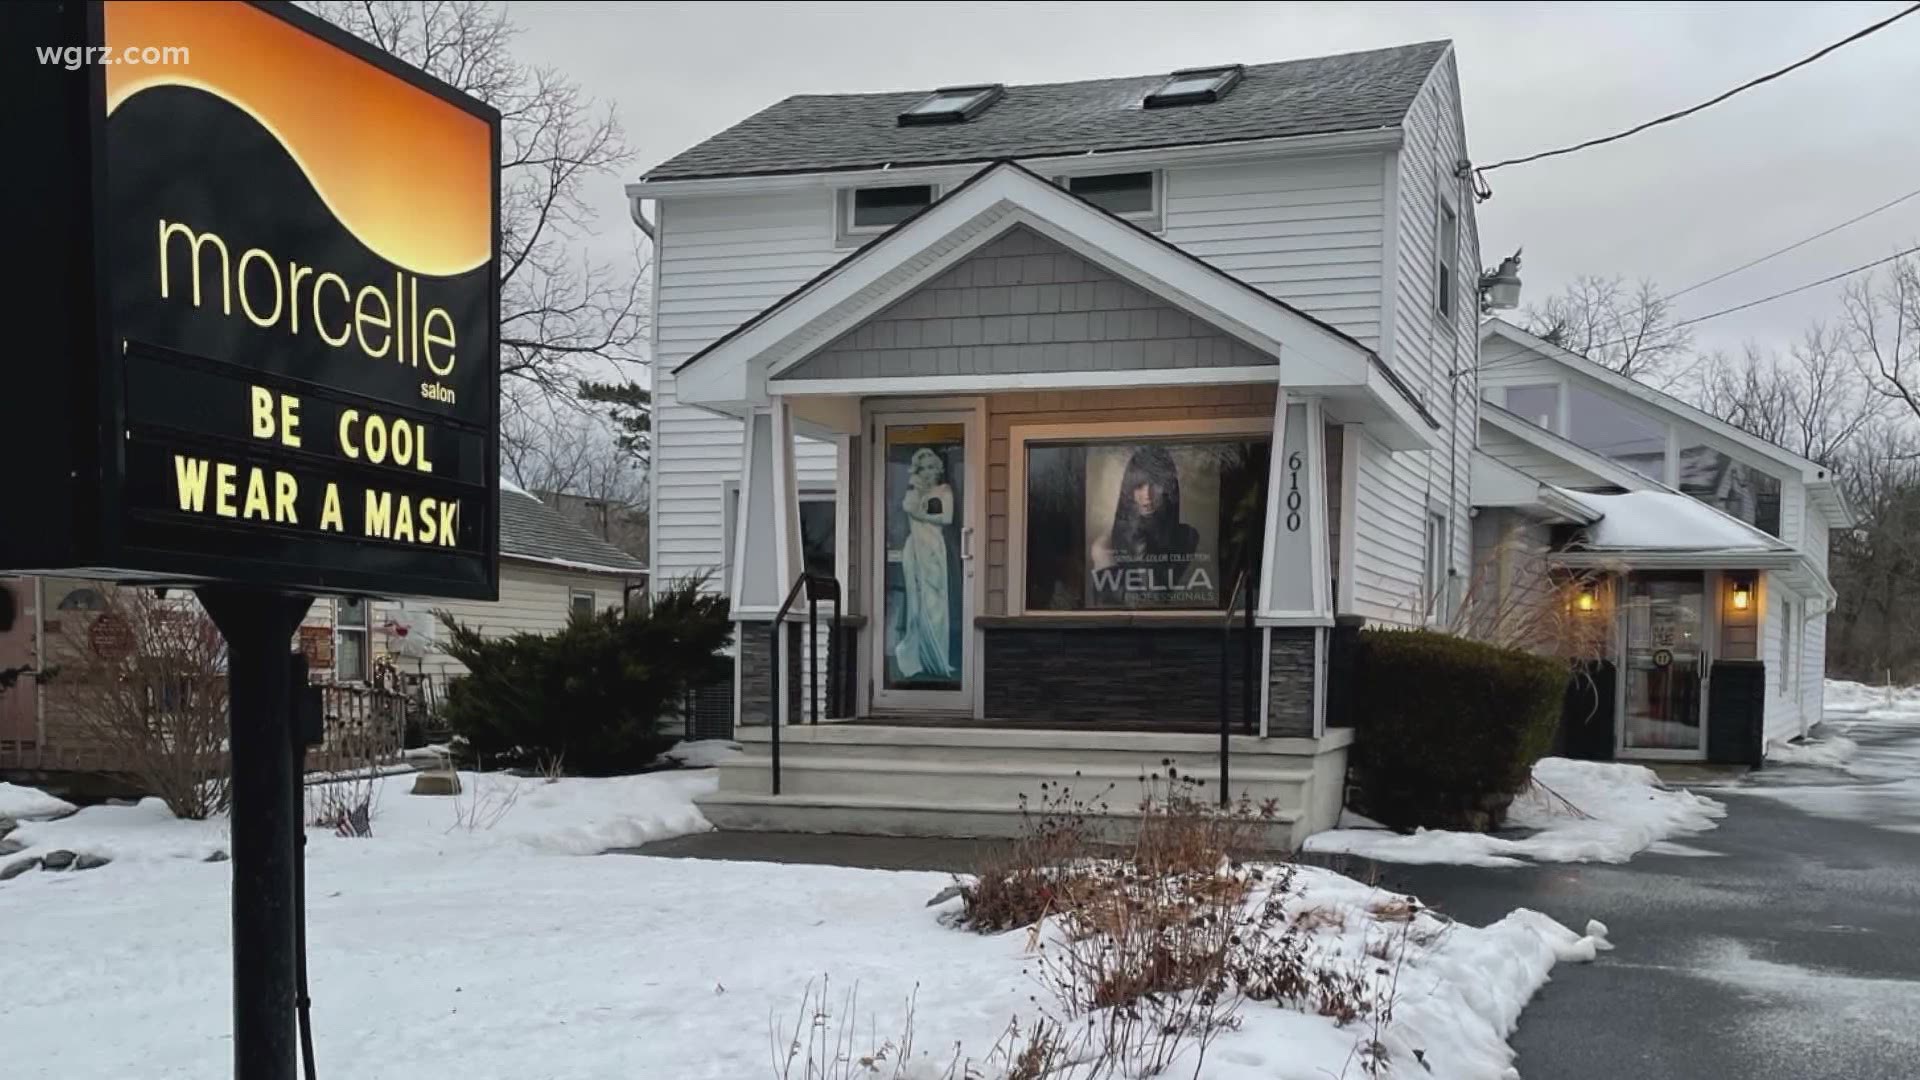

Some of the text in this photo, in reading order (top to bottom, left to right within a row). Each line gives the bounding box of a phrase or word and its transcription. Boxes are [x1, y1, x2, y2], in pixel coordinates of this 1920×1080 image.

[159, 219, 456, 376] morcelle
[251, 385, 433, 473] BE COOL
[420, 381, 456, 404] salon
[174, 455, 457, 547] WEAR A MASK
[1286, 451, 1302, 532] 6100
[1091, 567, 1214, 591] WELLA
